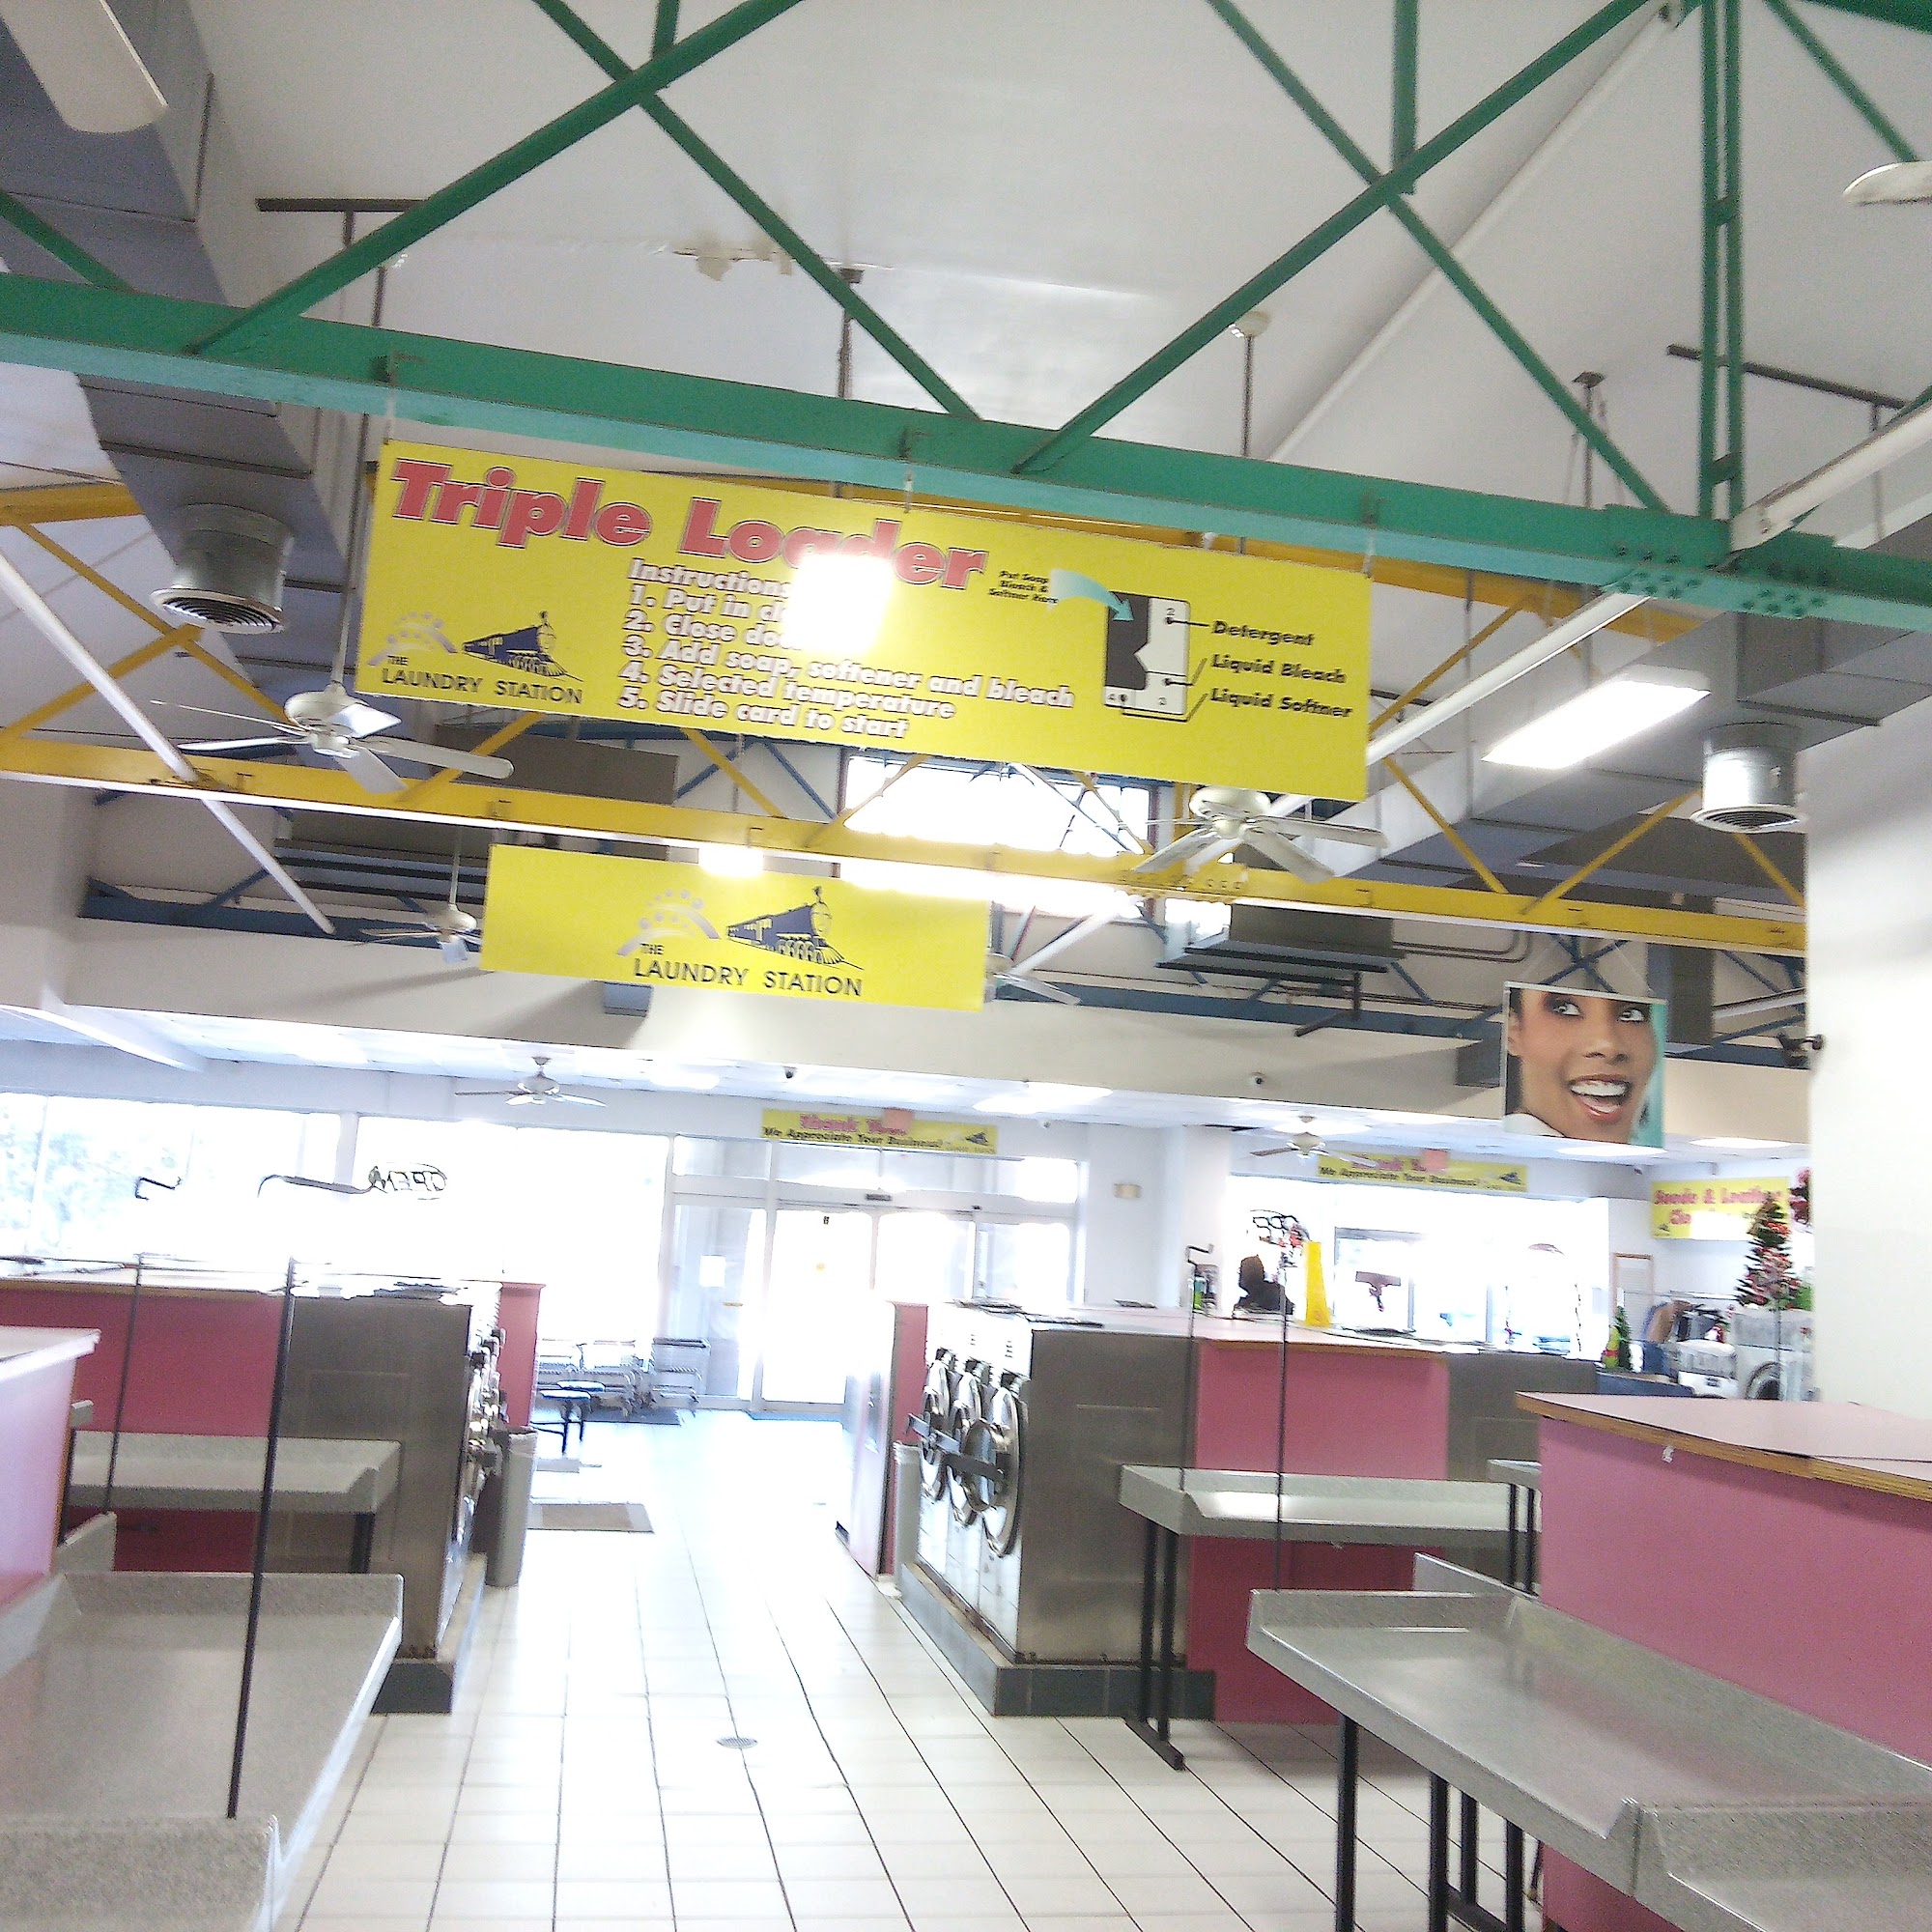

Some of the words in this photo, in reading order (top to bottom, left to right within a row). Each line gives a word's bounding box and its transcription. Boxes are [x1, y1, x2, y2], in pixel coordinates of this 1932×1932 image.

[390, 458, 653, 549] Triple
[677, 496, 988, 589] Loader
[630, 582, 656, 607] 1.
[663, 587, 718, 615] Put
[720, 594, 752, 619] in
[622, 609, 655, 633] 2.
[664, 612, 737, 642] Close
[1211, 620, 1315, 646] Detergent
[388, 655, 409, 668] THE
[621, 634, 653, 659] 3.
[655, 638, 721, 667] Add
[809, 659, 923, 689] softener
[929, 675, 982, 696] and
[985, 676, 1075, 709] bleach
[1211, 654, 1275, 674] Liquid
[1280, 663, 1349, 684] Bleach
[382, 668, 483, 694] LAUNDRY
[496, 681, 583, 704] STATION
[618, 659, 651, 684] 4.
[658, 663, 779, 698] Selected
[783, 680, 956, 719] temperature
[1210, 688, 1274, 708] Liquid
[617, 685, 649, 710] 5.
[656, 689, 729, 719] Slide
[736, 703, 800, 726] card
[805, 707, 836, 730] to
[841, 714, 910, 738] start
[640, 943, 665, 956] THE
[634, 958, 749, 986] LAUNDRY
[763, 970, 864, 997] STATION
[799, 1113, 858, 1132] Thank
